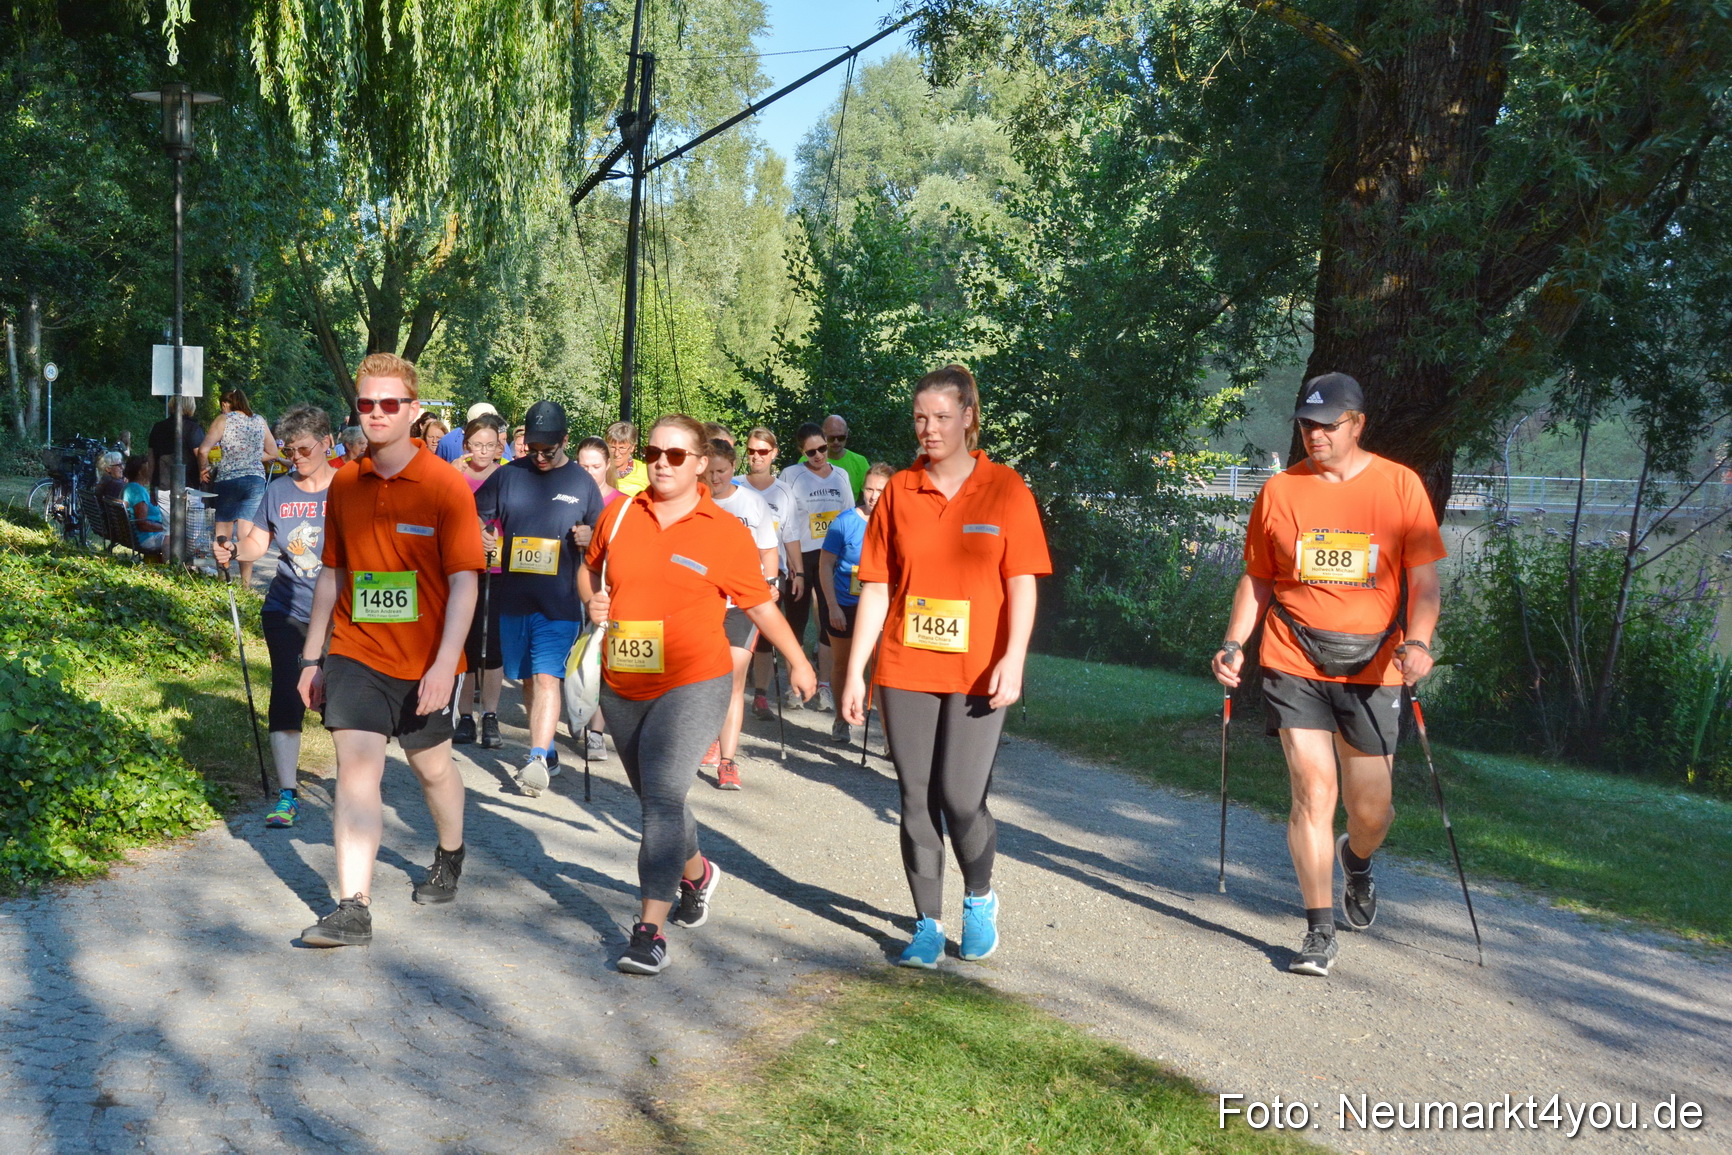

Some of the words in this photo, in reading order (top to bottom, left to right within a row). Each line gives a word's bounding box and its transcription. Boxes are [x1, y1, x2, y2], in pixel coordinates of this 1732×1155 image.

[280, 501, 318, 519] GIVE
[1314, 549, 1353, 568] 888
[360, 589, 408, 608] 1486
[912, 614, 959, 637] 1484
[610, 637, 654, 658] 1483
